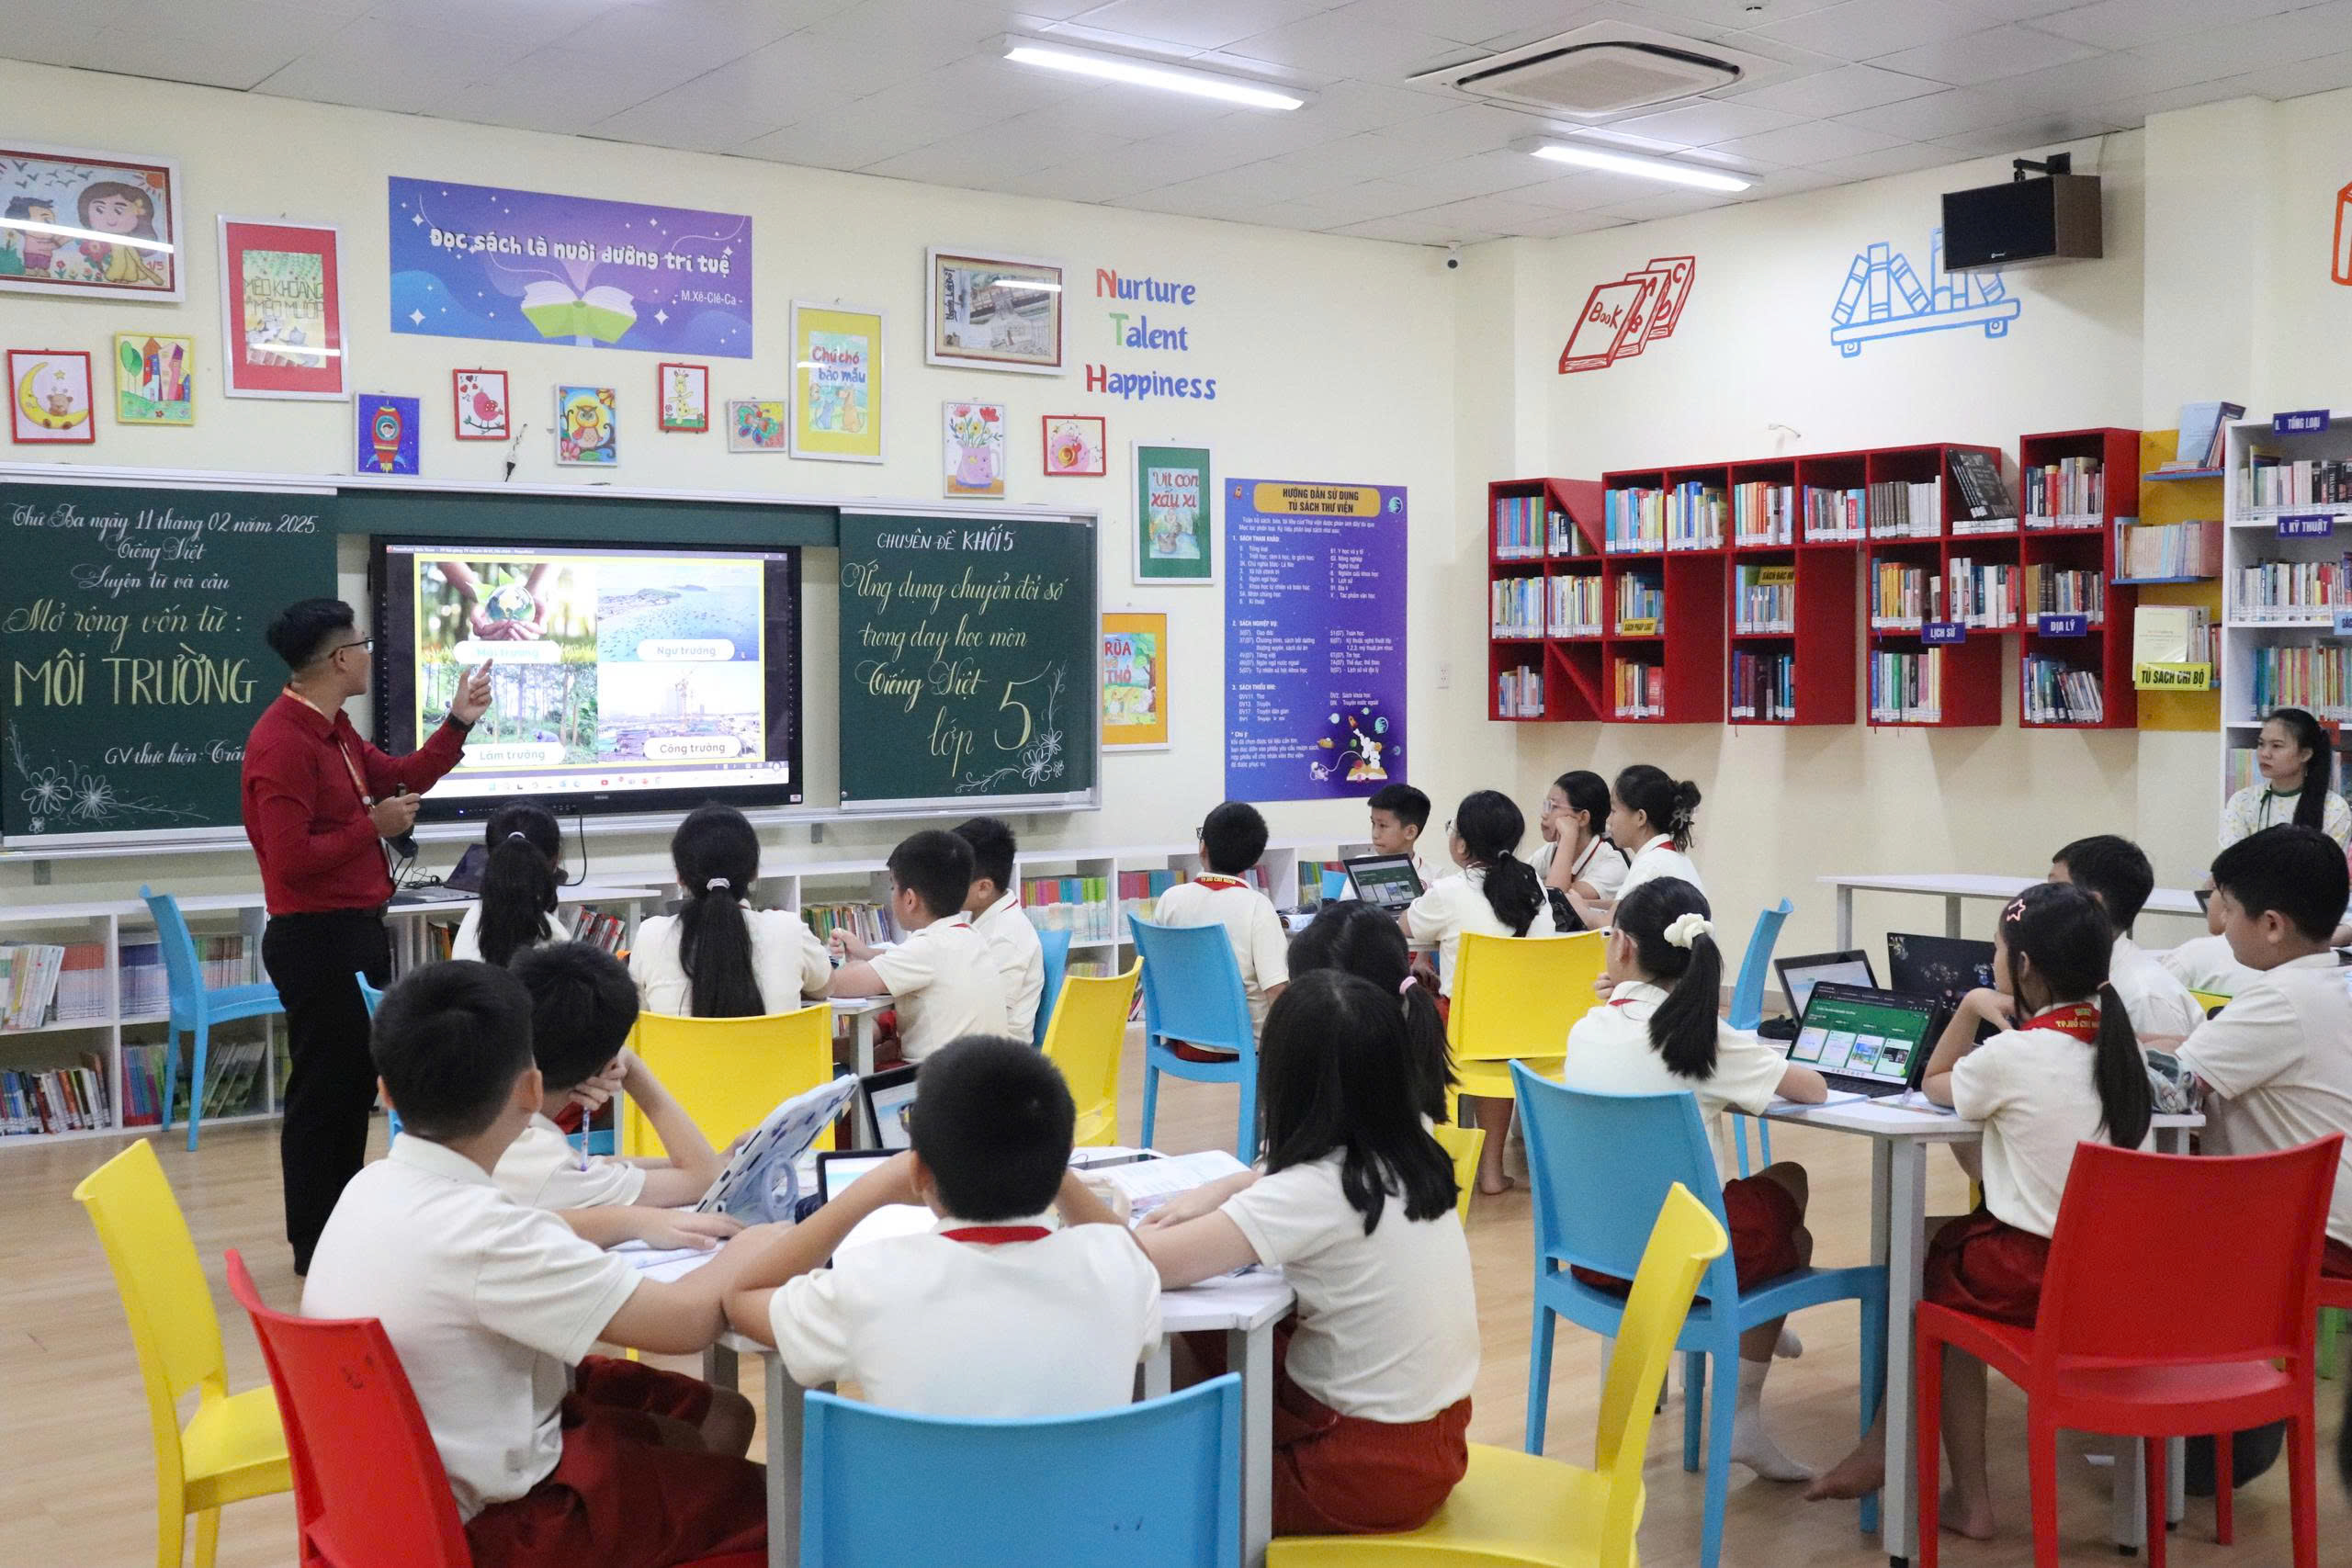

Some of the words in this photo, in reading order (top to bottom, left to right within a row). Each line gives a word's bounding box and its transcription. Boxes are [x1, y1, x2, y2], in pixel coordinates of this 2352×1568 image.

[430, 228, 469, 252] Đọc
[474, 232, 522, 255] sách
[528, 236, 548, 257] là
[554, 239, 595, 262] nuôi
[602, 244, 659, 269] dưỡng
[666, 251, 694, 272] trí
[698, 249, 730, 277] tuệ
[1096, 268, 1195, 305] Nurture
[1109, 312, 1189, 351] Talent
[812, 345, 837, 363] Chú
[839, 350, 859, 365] chó
[1085, 364, 1216, 400] Happiness
[2288, 415, 2304, 429] TỔNG
[2305, 417, 2321, 431] LOẠI
[1175, 474, 1198, 487] con
[1151, 489, 1179, 507] xấu
[1283, 486, 1308, 499] HƯỚNG
[1288, 499, 1297, 511] TỦ
[1300, 501, 1318, 512] SÁCH
[1321, 502, 1335, 513] THƯ
[1337, 501, 1353, 514] VIỆN
[8, 502, 44, 528] Thứ
[49, 504, 84, 528] Ba
[90, 514, 128, 541] ngày
[136, 510, 152, 530] 11
[153, 508, 204, 542] tháng
[208, 514, 231, 531] 02
[232, 517, 272, 533] năm
[2289, 520, 2300, 533] KỸ
[2301, 518, 2327, 535] THUẬT
[877, 528, 931, 549] CHUYÊN
[933, 529, 956, 550] ĐỀ
[105, 536, 162, 570] Tiếng
[163, 536, 207, 563] Việt
[71, 565, 141, 598] Luyện
[149, 568, 167, 589] từ
[174, 574, 195, 589] và
[201, 574, 230, 589] câu
[842, 559, 892, 615] Ứng
[899, 571, 946, 615] dụng
[951, 566, 1012, 615] chuyển
[1014, 573, 1040, 600] đổi
[1045, 578, 1069, 601] số
[4, 598, 67, 633] Mở
[74, 605, 131, 653] rộng
[142, 603, 188, 632] vốn
[1930, 628, 1944, 639] LỊCH
[1947, 625, 1956, 637] SỬ
[2051, 621, 2064, 633] ĐỊA
[2065, 619, 2075, 632] LÝ
[859, 623, 906, 662] trong
[955, 614, 983, 652] học
[989, 628, 1028, 648] môn
[1104, 638, 1132, 655] RÙA
[657, 647, 679, 657] Ngư
[681, 647, 716, 657] trường
[15, 649, 86, 706] MÔI
[102, 643, 258, 705] TRƯỜNG
[1106, 665, 1132, 683] THỎ
[2142, 666, 2151, 683] TỦ
[2193, 669, 2204, 687] BỘ
[854, 660, 924, 713] Tiếng
[928, 657, 989, 701] Việt
[928, 706, 974, 777] lớp
[995, 661, 1052, 750] 5
[105, 747, 133, 764] GV
[134, 742, 164, 767] thực
[507, 750, 545, 761] trường
[660, 743, 687, 755] Công
[691, 742, 725, 753] trường
